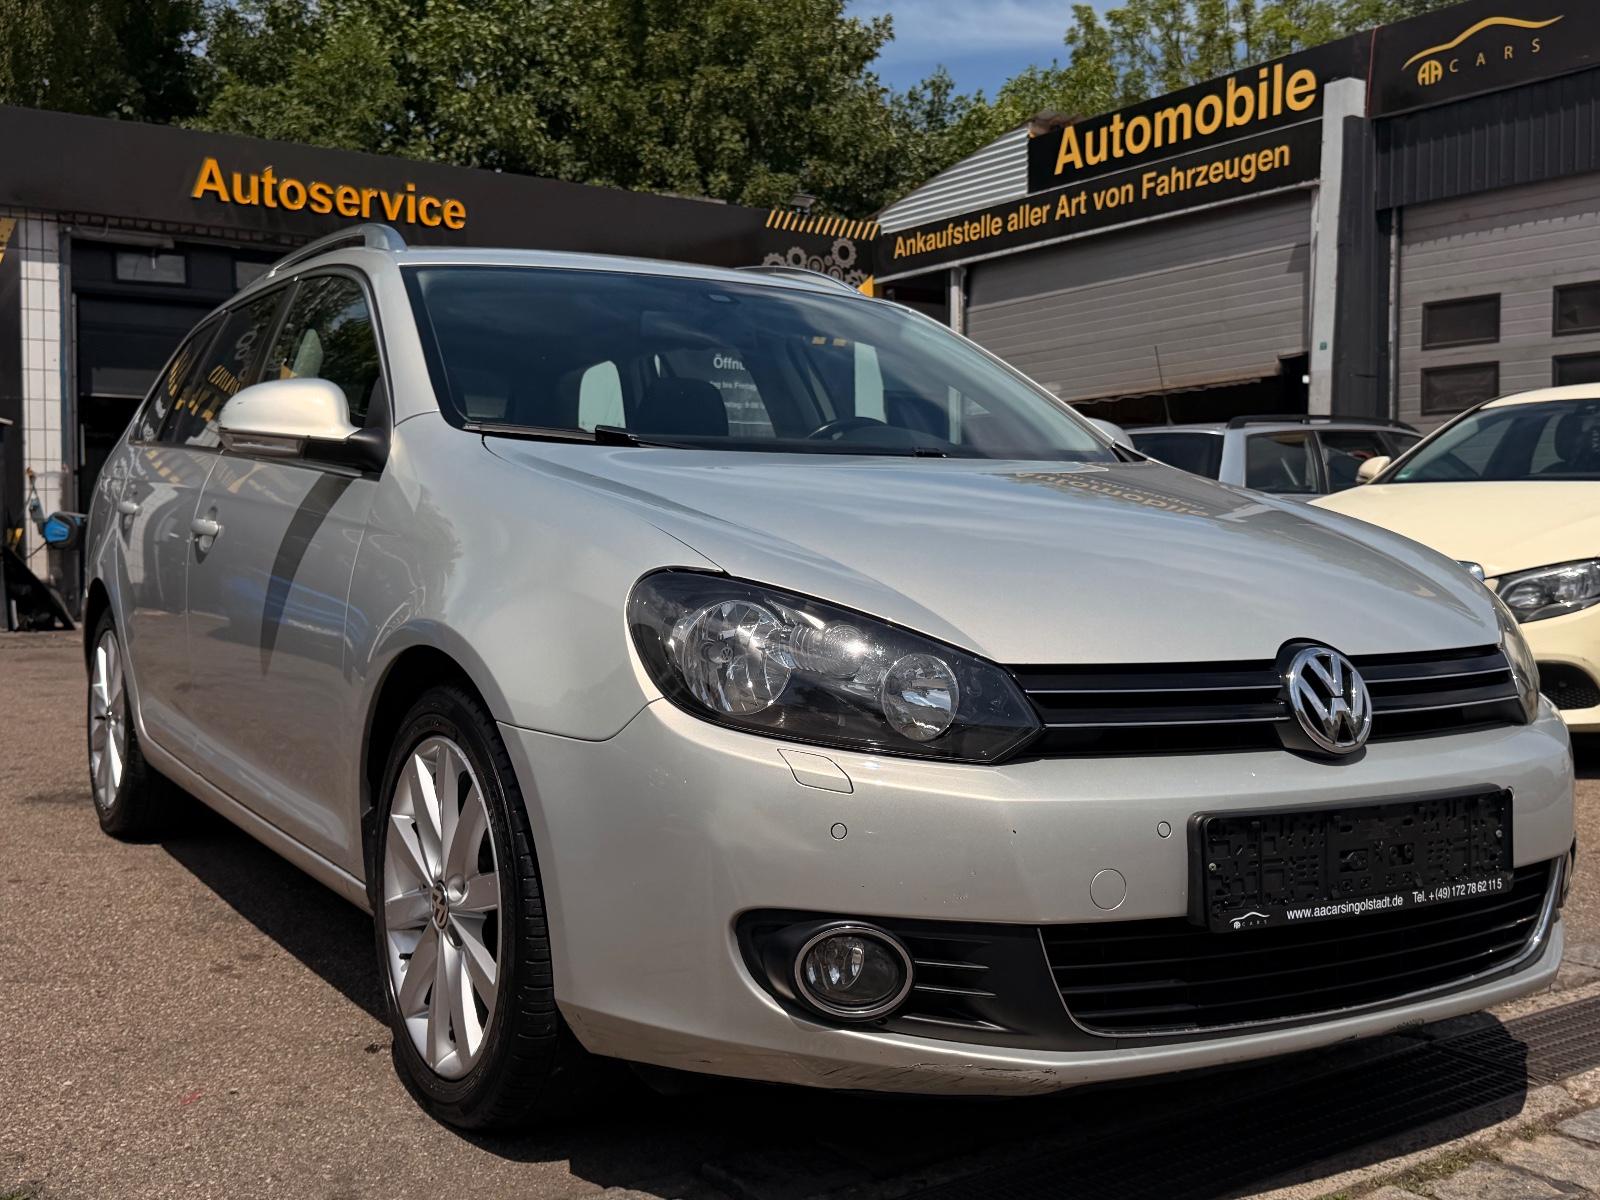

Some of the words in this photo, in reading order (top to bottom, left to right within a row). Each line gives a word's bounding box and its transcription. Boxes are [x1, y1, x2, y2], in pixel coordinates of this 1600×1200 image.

[1417, 59, 1443, 86] AA
[1449, 38, 1541, 73] CARS
[1053, 64, 1317, 176] Automobile
[191, 156, 467, 230] Autoservice
[893, 214, 1003, 259] Ankaufstelle
[1006, 203, 1049, 233] aller
[1054, 193, 1088, 221] Art
[1093, 180, 1135, 211] von
[1141, 144, 1290, 200] Fahrzeugen
[1290, 648, 1371, 752] VW
[1286, 894, 1404, 920] www.aacarsingolstadt.de
[1412, 890, 1427, 903] Tel.
[1451, 884, 1466, 897] 172
